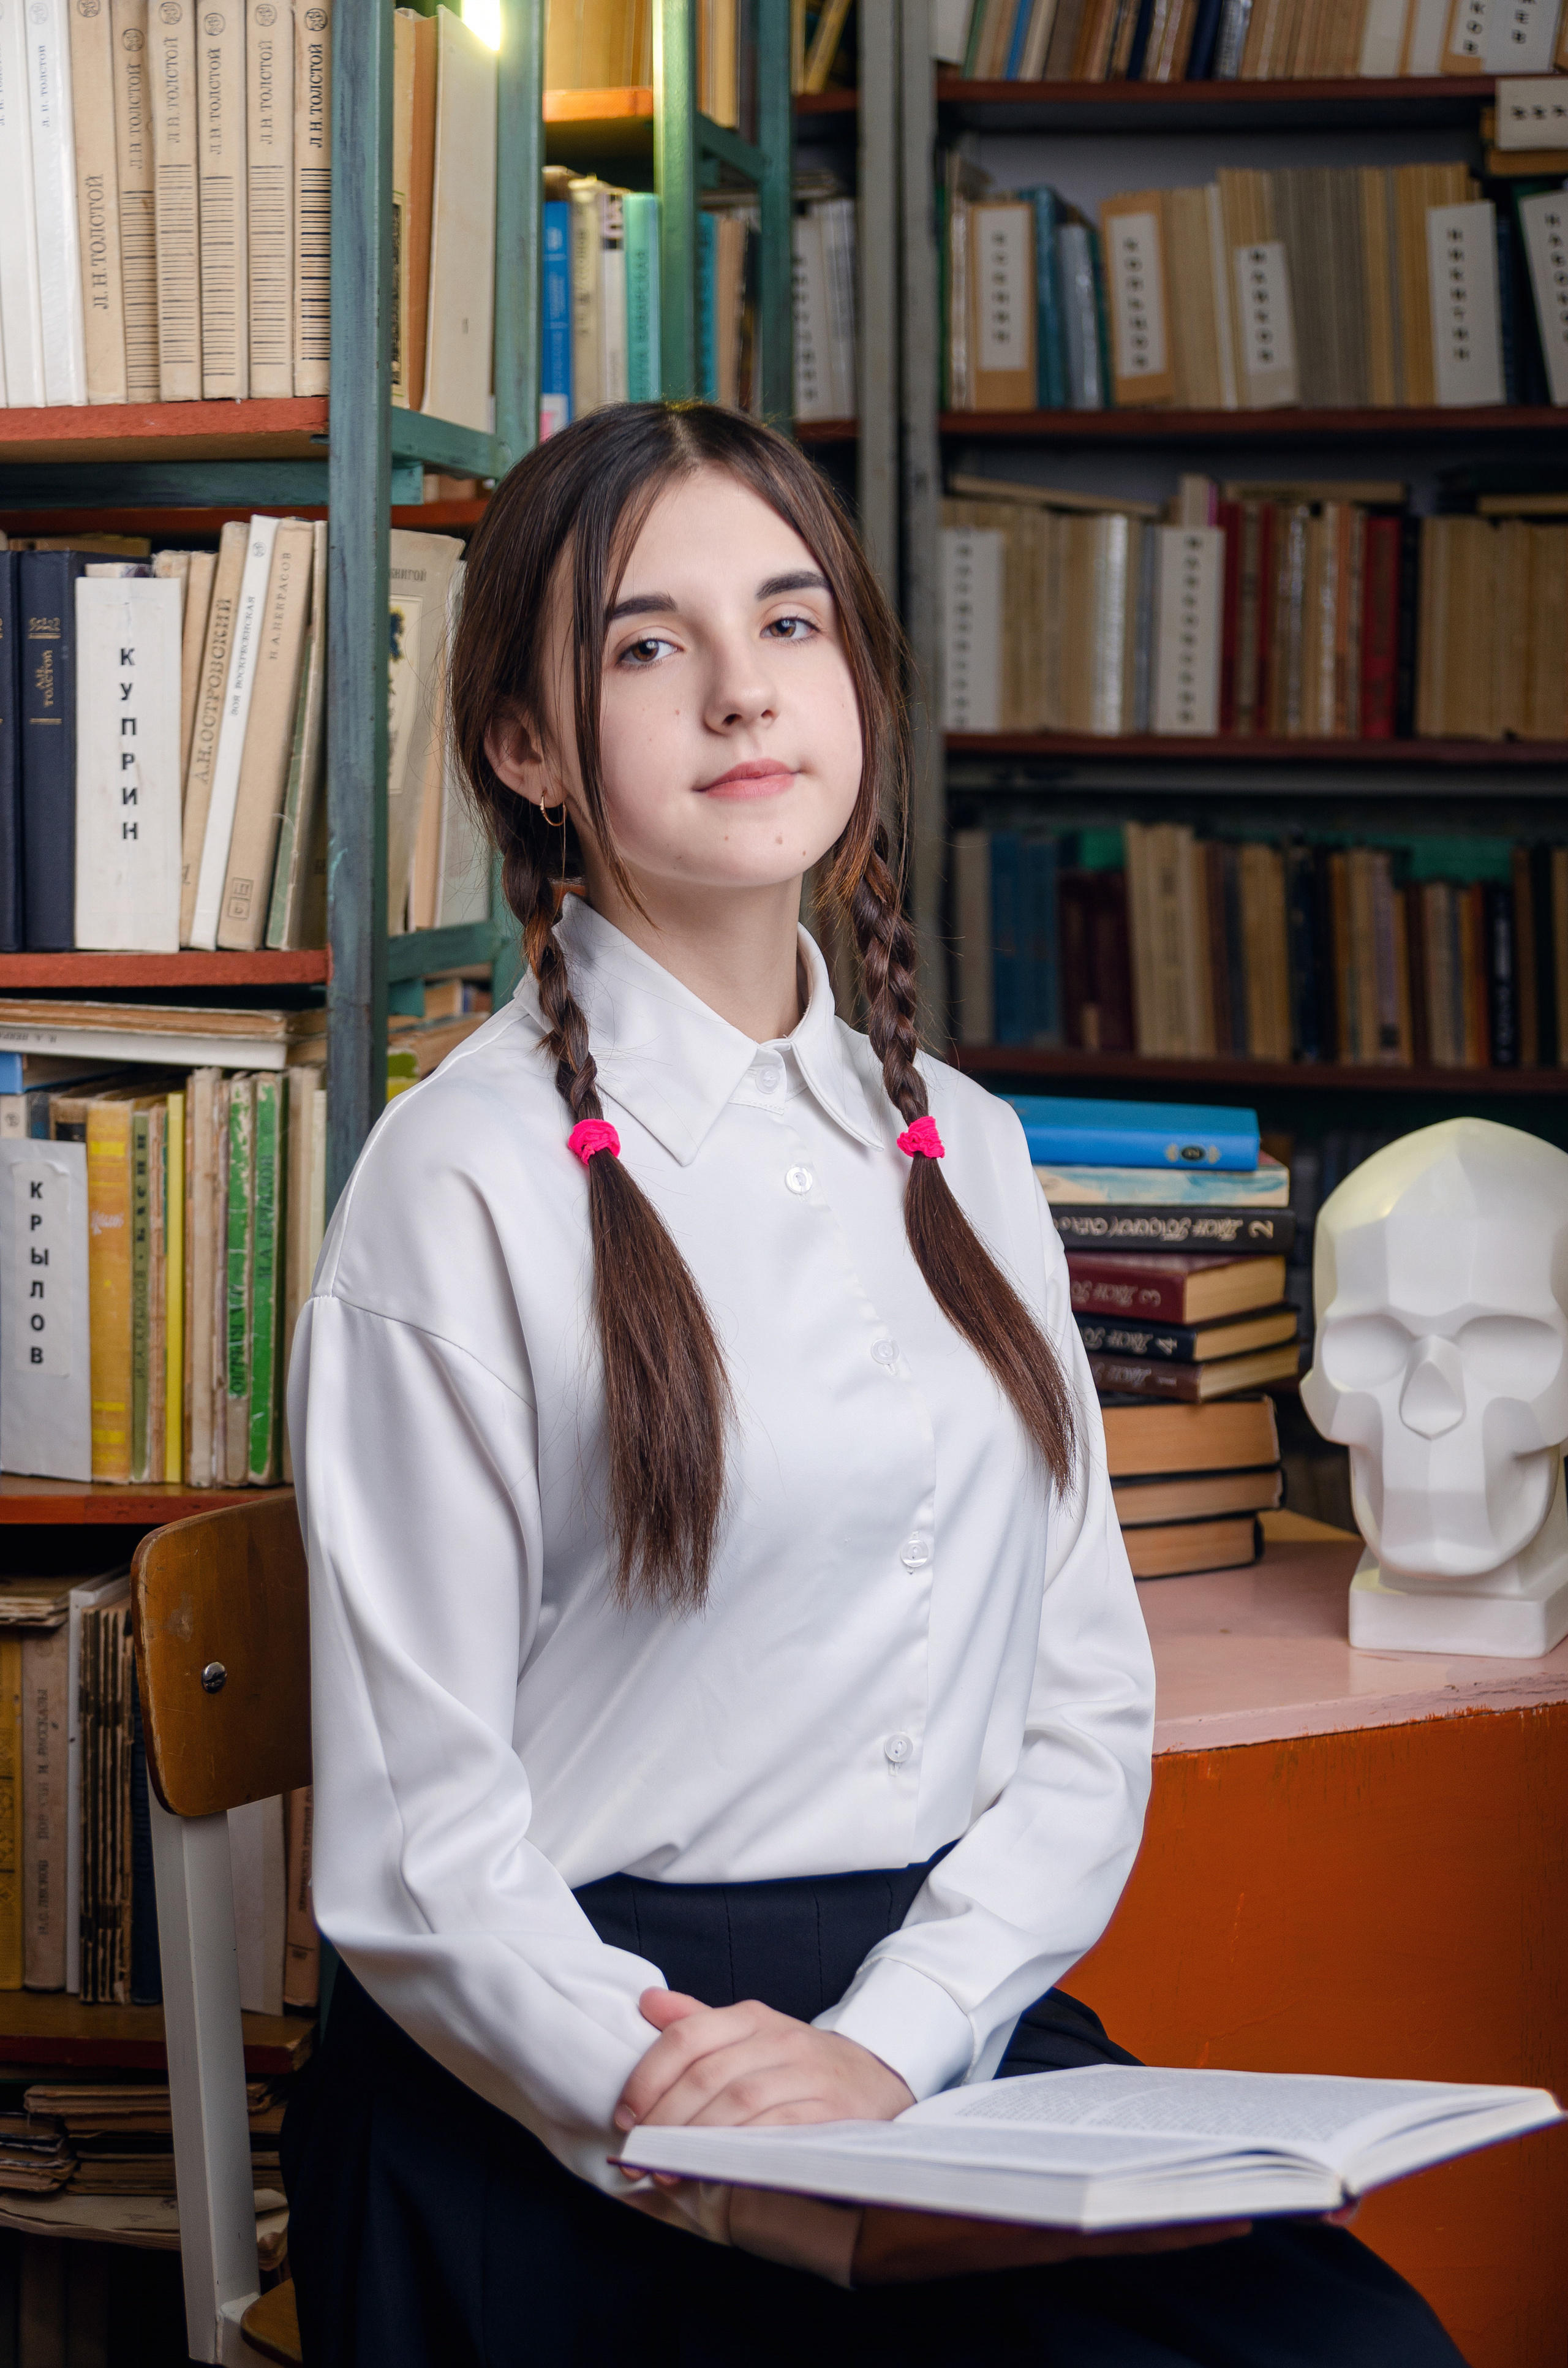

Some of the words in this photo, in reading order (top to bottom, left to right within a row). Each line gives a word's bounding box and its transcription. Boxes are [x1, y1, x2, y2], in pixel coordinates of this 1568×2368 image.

[126, 63, 141, 137] ТОЛСТОЙ
[163, 36, 181, 111] ТОЛСТОЙ
[206, 47, 222, 123] ТОЛСТОЙ
[257, 40, 273, 112] ТОЛСТОЙ
[307, 43, 323, 115] ТОЛСТОЙ
[84, 174, 108, 267] ТОЛСТОЙ
[271, 551, 292, 630] НЕКРАСОВ
[200, 597, 232, 742] ОСТРОВСКИЙ
[235, 596, 256, 690] ВОСКРЕСЕНСКАЯ
[119, 648, 138, 840] КУПРИН
[1248, 1219, 1274, 1239] 2
[30, 1181, 49, 1364] КРЫЛОВ
[1139, 1288, 1162, 1307] 3
[1155, 1337, 1178, 1355] 4
[36, 1689, 49, 1756] РАССКАЗЫ
[36, 1782, 49, 1840] ПОВСТИ
